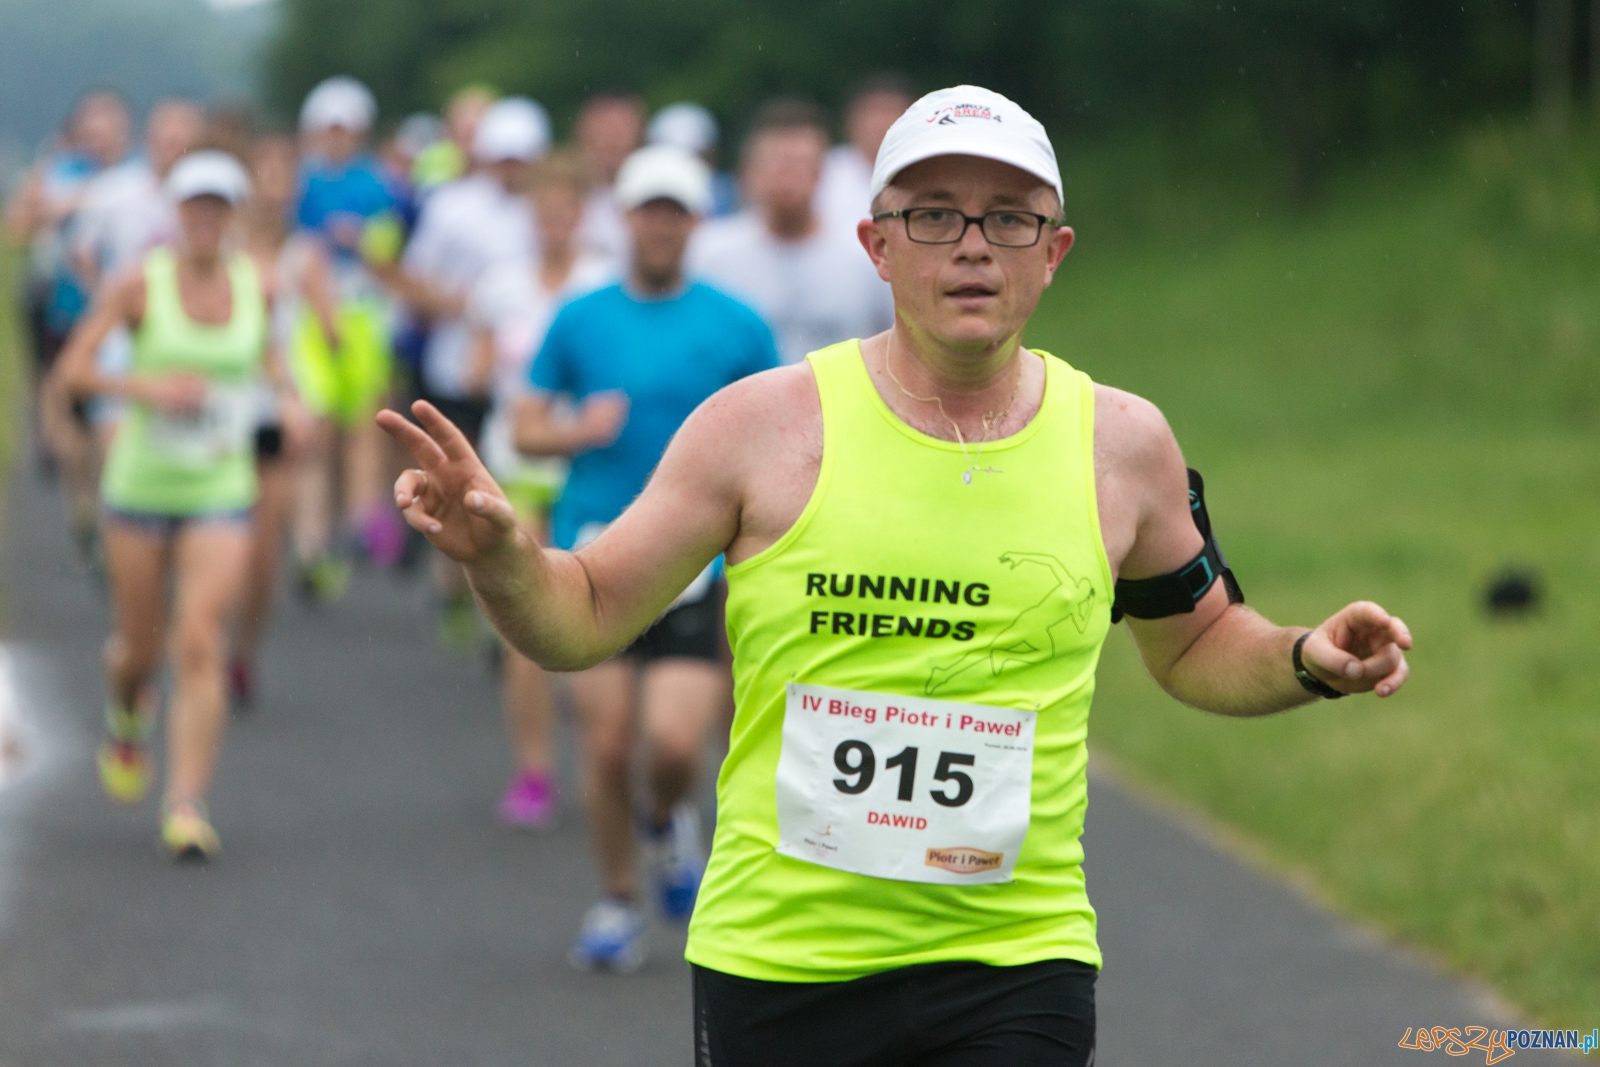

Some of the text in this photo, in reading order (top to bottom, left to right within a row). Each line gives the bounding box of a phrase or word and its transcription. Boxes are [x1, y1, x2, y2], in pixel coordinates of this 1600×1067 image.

[806, 573, 990, 607] RUNNING
[810, 611, 977, 641] FRIENDS
[802, 694, 1022, 737] IV Bieg Piotr i Paweł
[832, 739, 976, 808] 915
[867, 811, 928, 830] DAWID
[929, 851, 957, 864] Piotr
[961, 854, 965, 865] i
